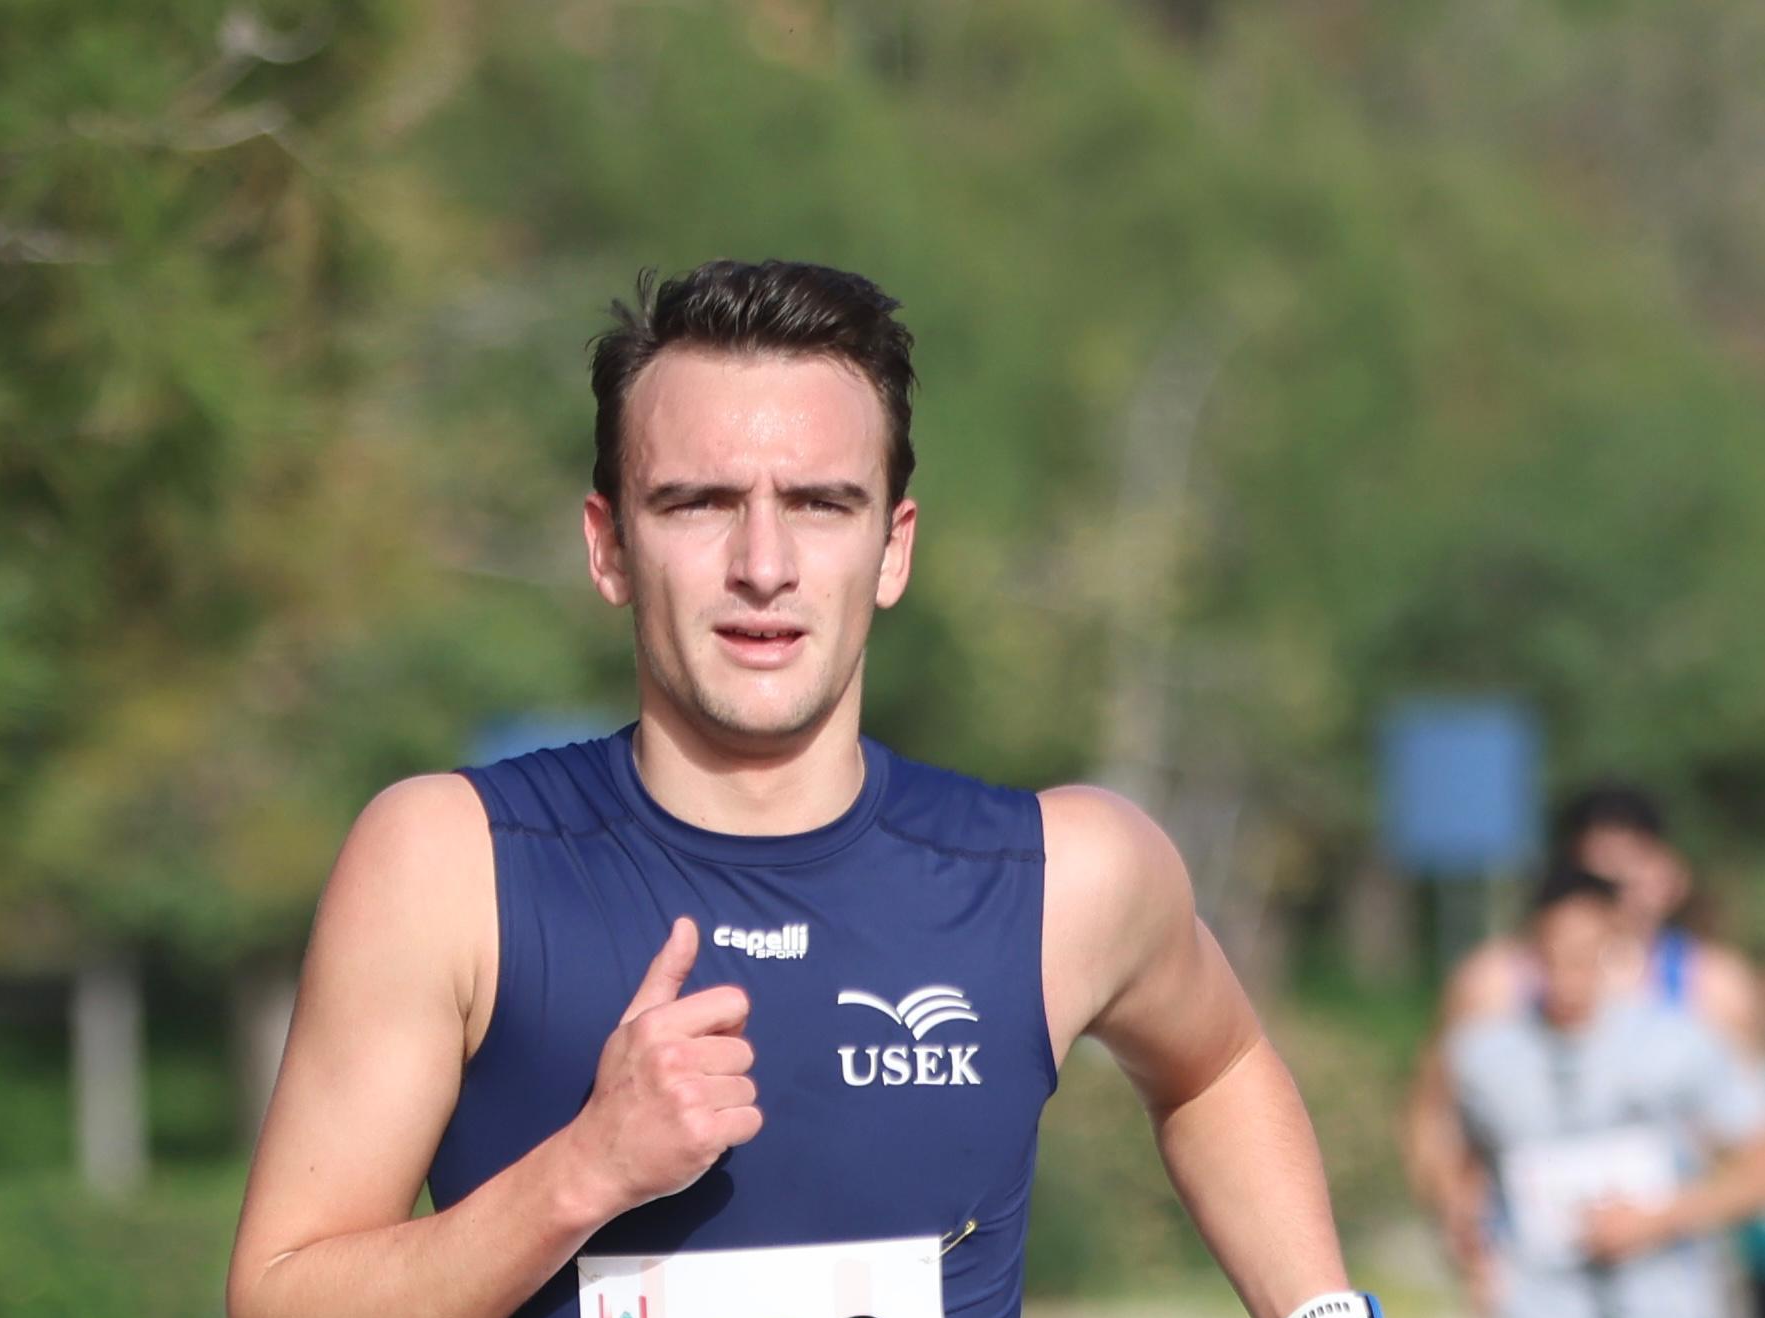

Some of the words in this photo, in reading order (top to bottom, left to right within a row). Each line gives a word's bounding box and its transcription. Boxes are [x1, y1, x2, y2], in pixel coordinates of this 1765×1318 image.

[713, 924, 809, 956] capelli
[755, 949, 806, 960] SPORT
[837, 1045, 982, 1086] USEK
